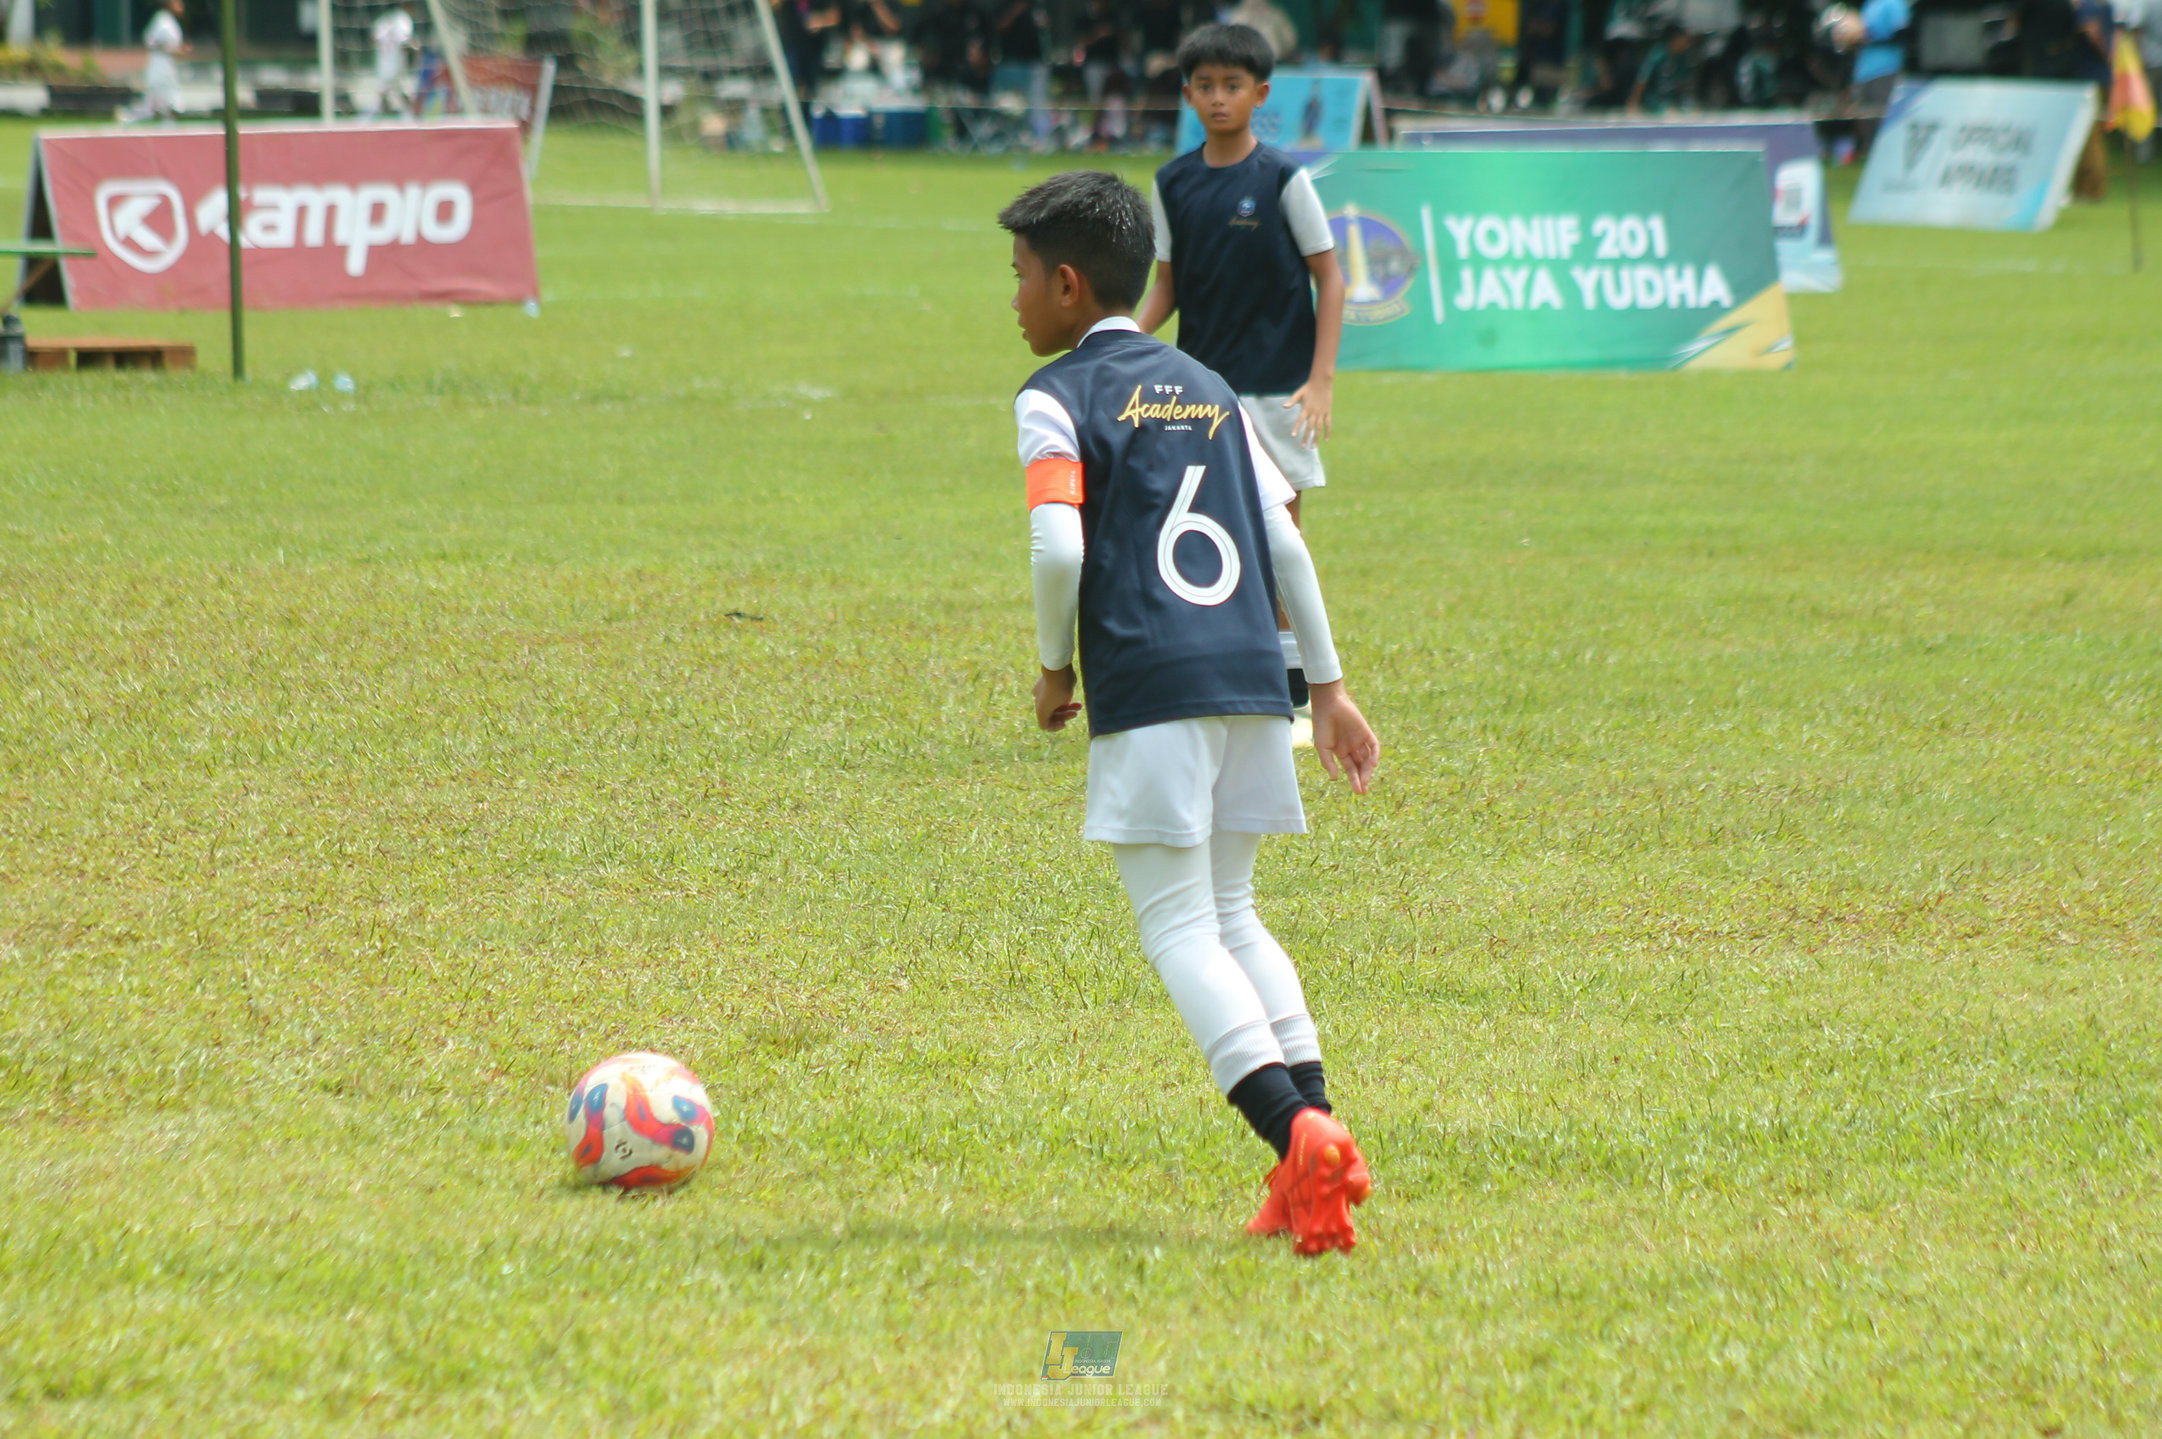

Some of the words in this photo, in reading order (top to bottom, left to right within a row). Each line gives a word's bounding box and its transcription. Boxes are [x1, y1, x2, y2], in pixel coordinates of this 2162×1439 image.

[1444, 214, 1582, 260] YONIF
[1591, 213, 1669, 259] 201
[1454, 265, 1565, 311] JAYA
[1570, 261, 1735, 310] YUDHA
[1117, 384, 1230, 440] Academy
[1153, 384, 1184, 395] FFF
[1157, 465, 1241, 606] 6
